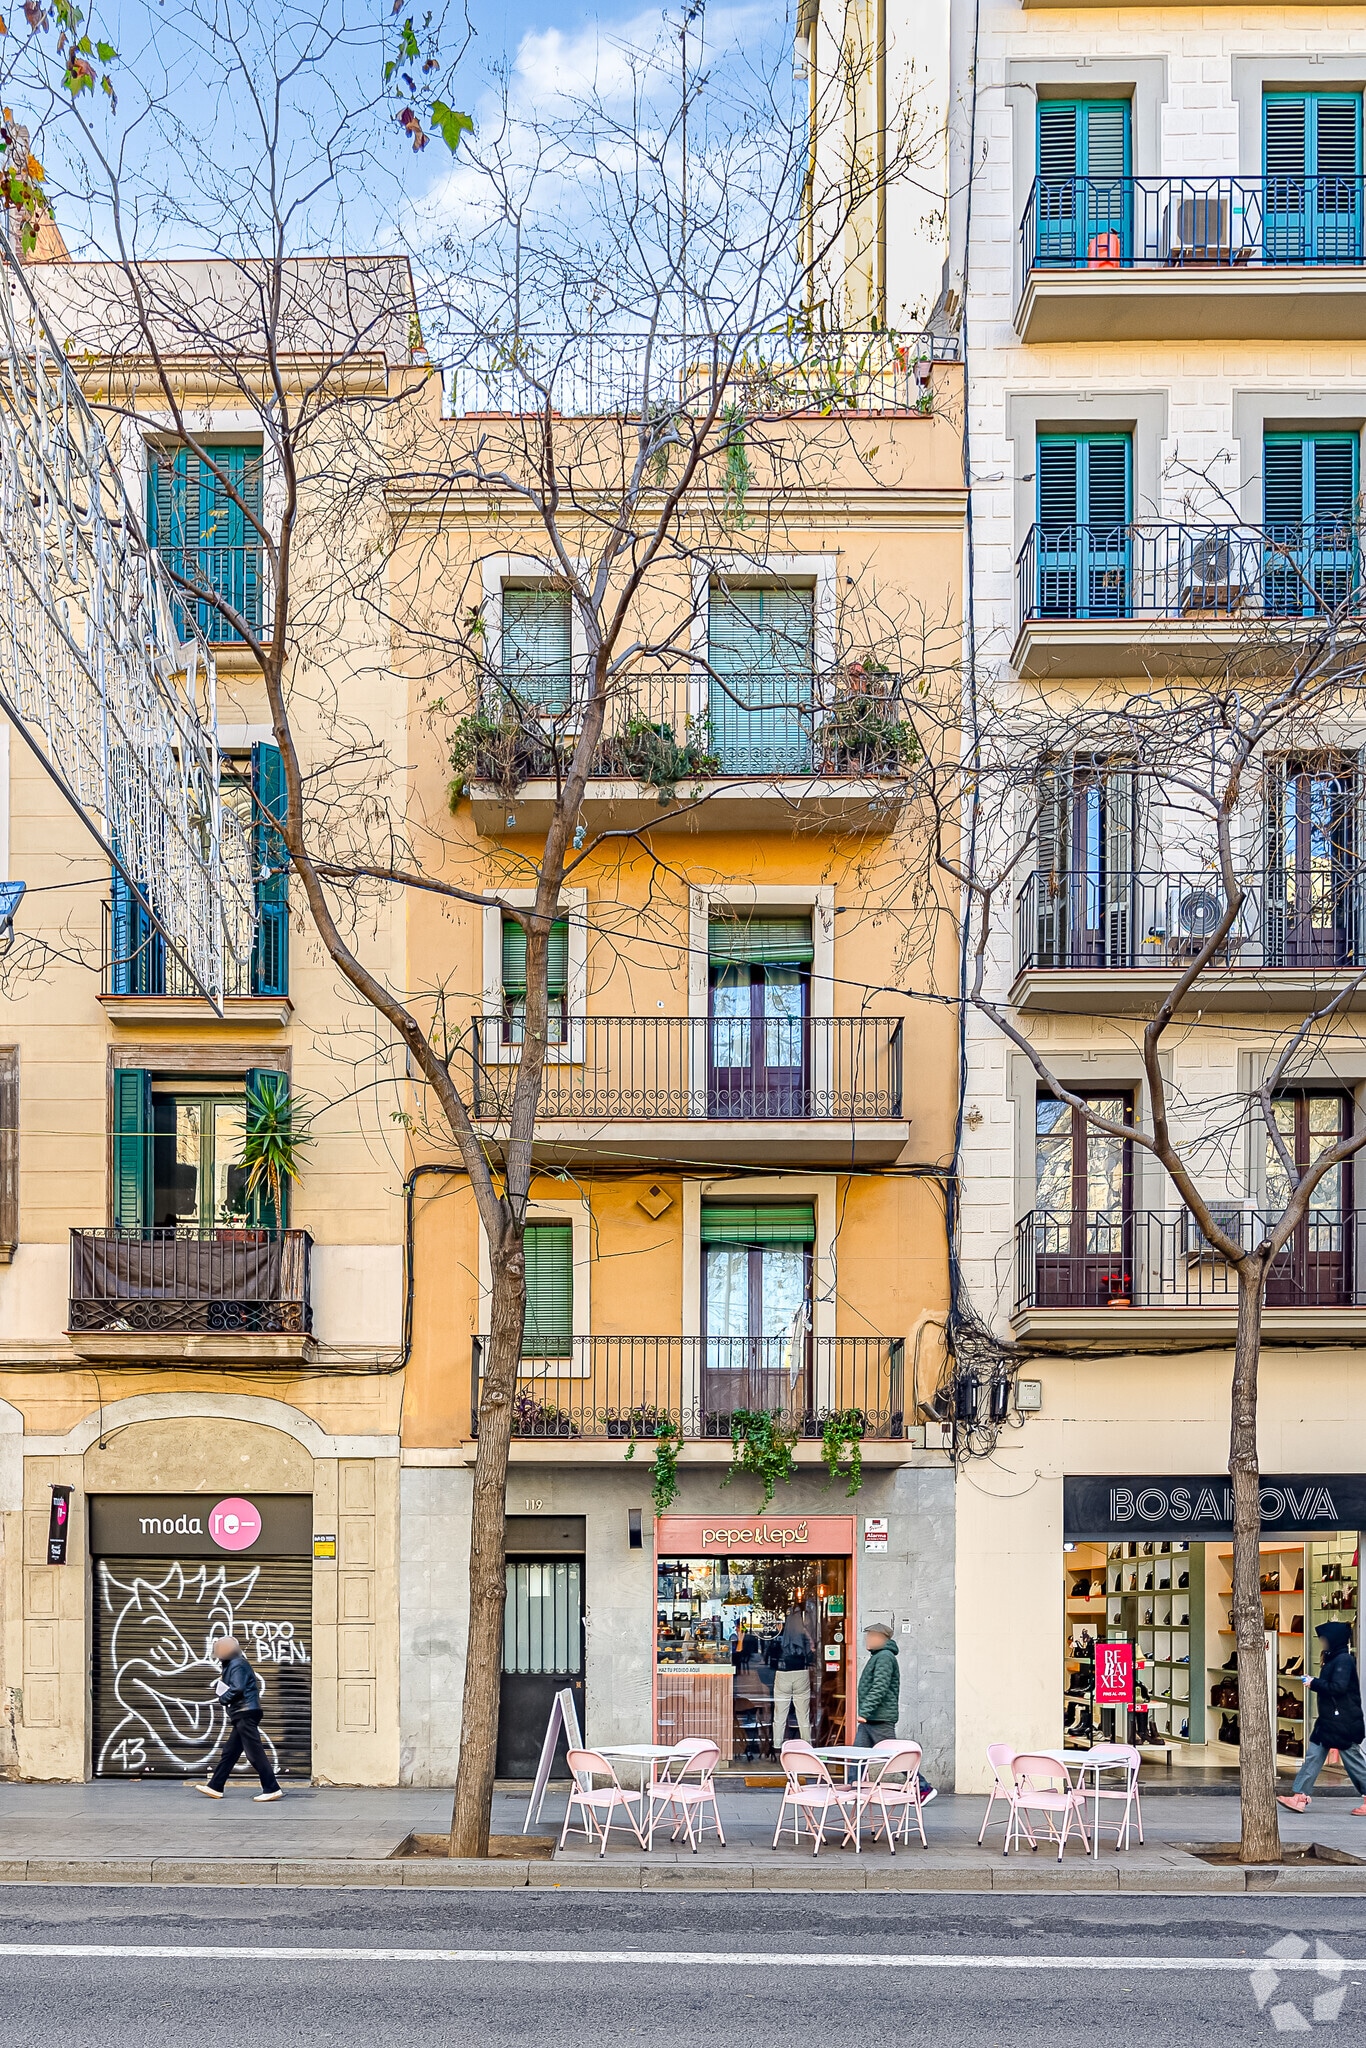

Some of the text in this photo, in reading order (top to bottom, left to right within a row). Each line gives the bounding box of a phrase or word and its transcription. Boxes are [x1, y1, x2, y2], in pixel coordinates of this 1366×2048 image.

[525, 1499, 543, 1510] 119
[139, 1514, 203, 1534] moda
[235, 1620, 294, 1641] TODO
[1104, 1662, 1127, 1676] BAI
[1101, 1675, 1126, 1688] XES
[111, 1738, 147, 1770] 43
